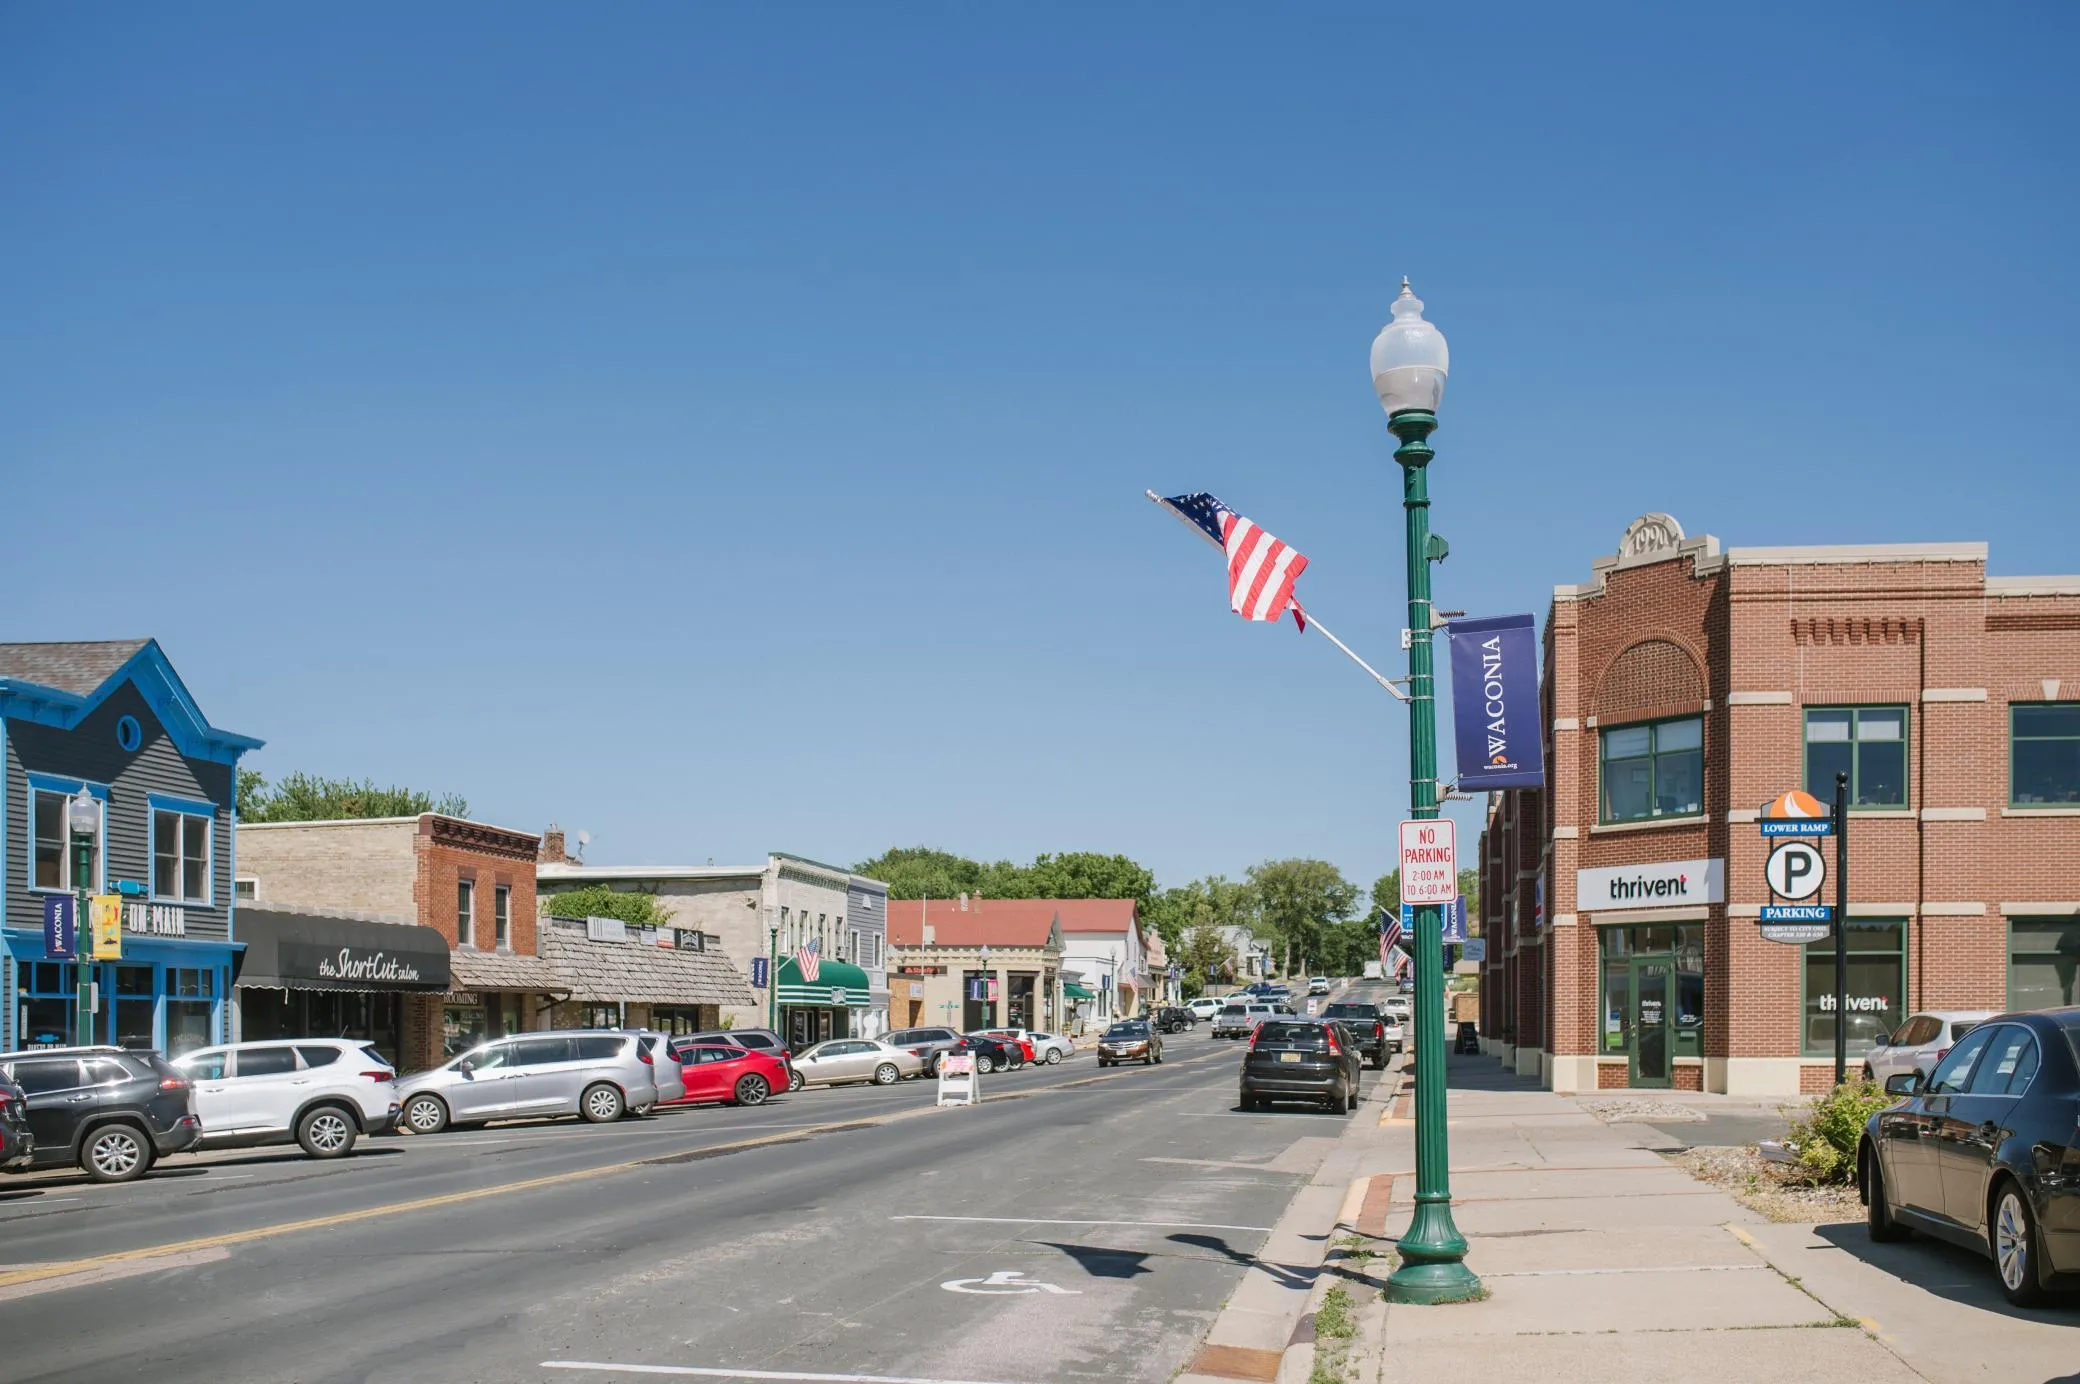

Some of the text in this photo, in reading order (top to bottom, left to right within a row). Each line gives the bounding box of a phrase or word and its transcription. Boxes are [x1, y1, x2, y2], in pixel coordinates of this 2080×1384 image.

[1482, 635, 1508, 758] WACONIA
[1483, 762, 1518, 770] waconia.org
[1419, 828, 1435, 844] NO
[1764, 824, 1828, 833] LOWER RAMP
[1405, 847, 1451, 863] PARKING
[1412, 870, 1445, 881] 2:00 AM
[1784, 851, 1812, 893] P
[1407, 884, 1451, 895] TO 6:00 AM
[1610, 874, 1687, 899] thrivent
[129, 903, 147, 933] ON
[153, 905, 185, 935] MAIN
[1766, 907, 1825, 918] PARKING
[54, 903, 63, 947] WACONIA
[320, 958, 336, 976] the
[398, 964, 419, 981] salon
[443, 992, 478, 1005] ROOMING
[1820, 993, 1889, 1011] thivent
